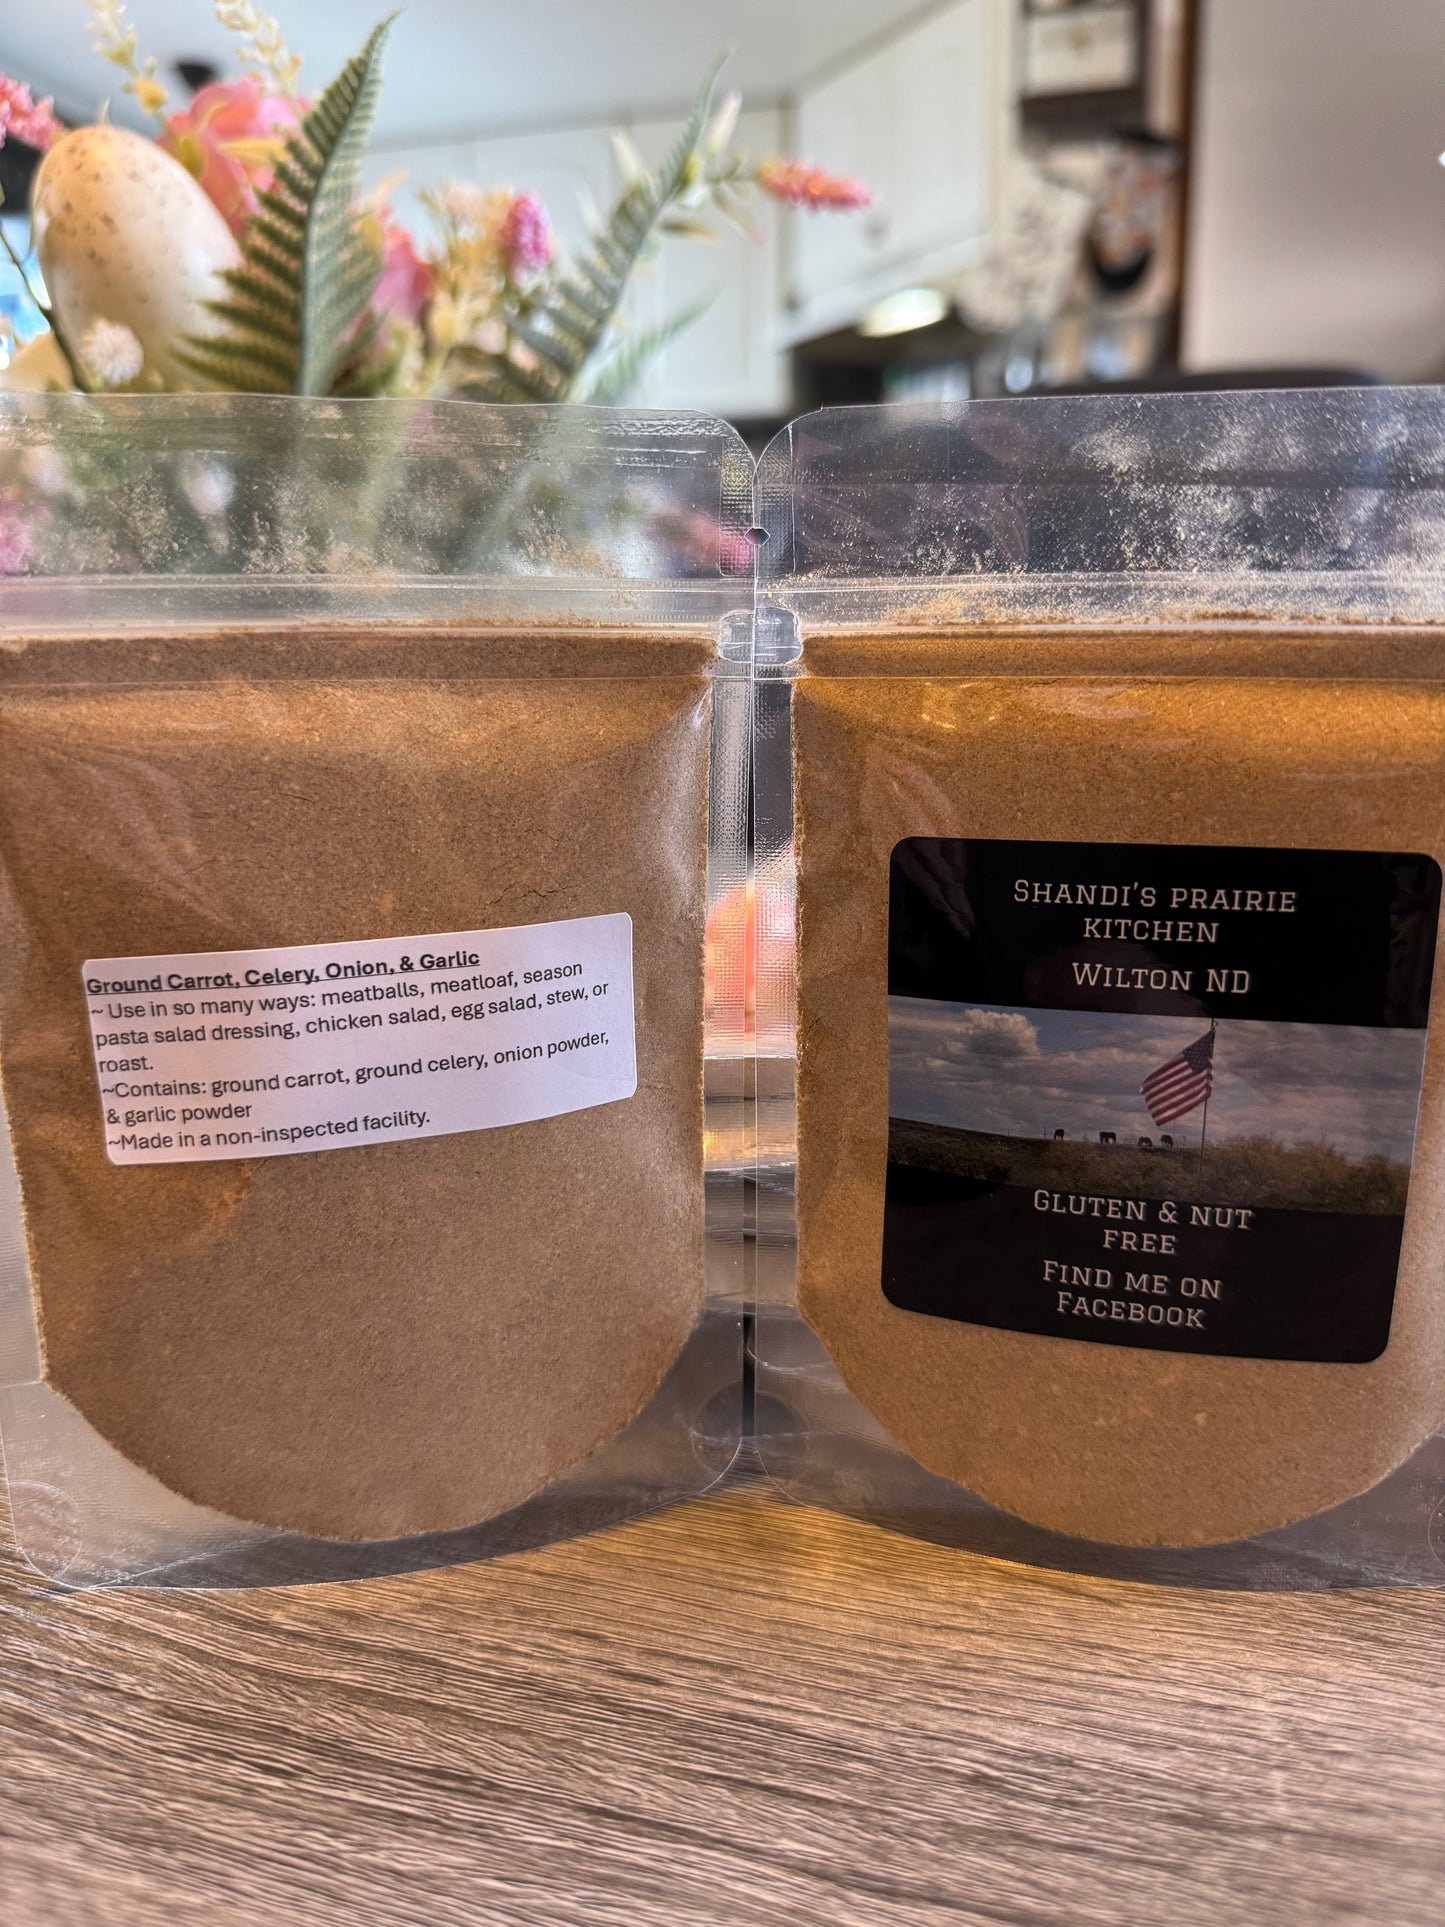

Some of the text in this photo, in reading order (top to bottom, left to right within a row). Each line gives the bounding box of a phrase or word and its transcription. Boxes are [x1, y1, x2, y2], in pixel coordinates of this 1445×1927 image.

[1014, 879, 1298, 912] SHANDI'S PRAIRIE
[1083, 917, 1220, 943] KITCHEN
[86, 951, 480, 994] Ground Carrot, Celery, Onion, & Garlic
[108, 1003, 145, 1019] Use
[151, 1001, 167, 1017] in
[174, 1003, 195, 1015] so
[201, 999, 254, 1016] many
[259, 994, 316, 1013] ways:
[322, 982, 425, 1005] meatballs,
[431, 971, 518, 994] meatloaf,
[523, 962, 582, 984] season
[1072, 962, 1251, 994] WILTON ND
[96, 981, 609, 1050] pasta salad dressing, chicken salad, egg salad, stew, or
[99, 1056, 154, 1072] roast.
[102, 1031, 609, 1098] ~Contains: ground carrot, ground celery, onion powder,
[107, 1103, 252, 1127] & garlic powder
[109, 1108, 430, 1150] ~Made in a non-inspected facility.
[1033, 1189, 1254, 1230] GLUTEN & NUT
[1103, 1228, 1177, 1255] FREE
[1042, 1259, 1222, 1299] FIND ME ON
[1056, 1291, 1206, 1329] FACEBOOK
